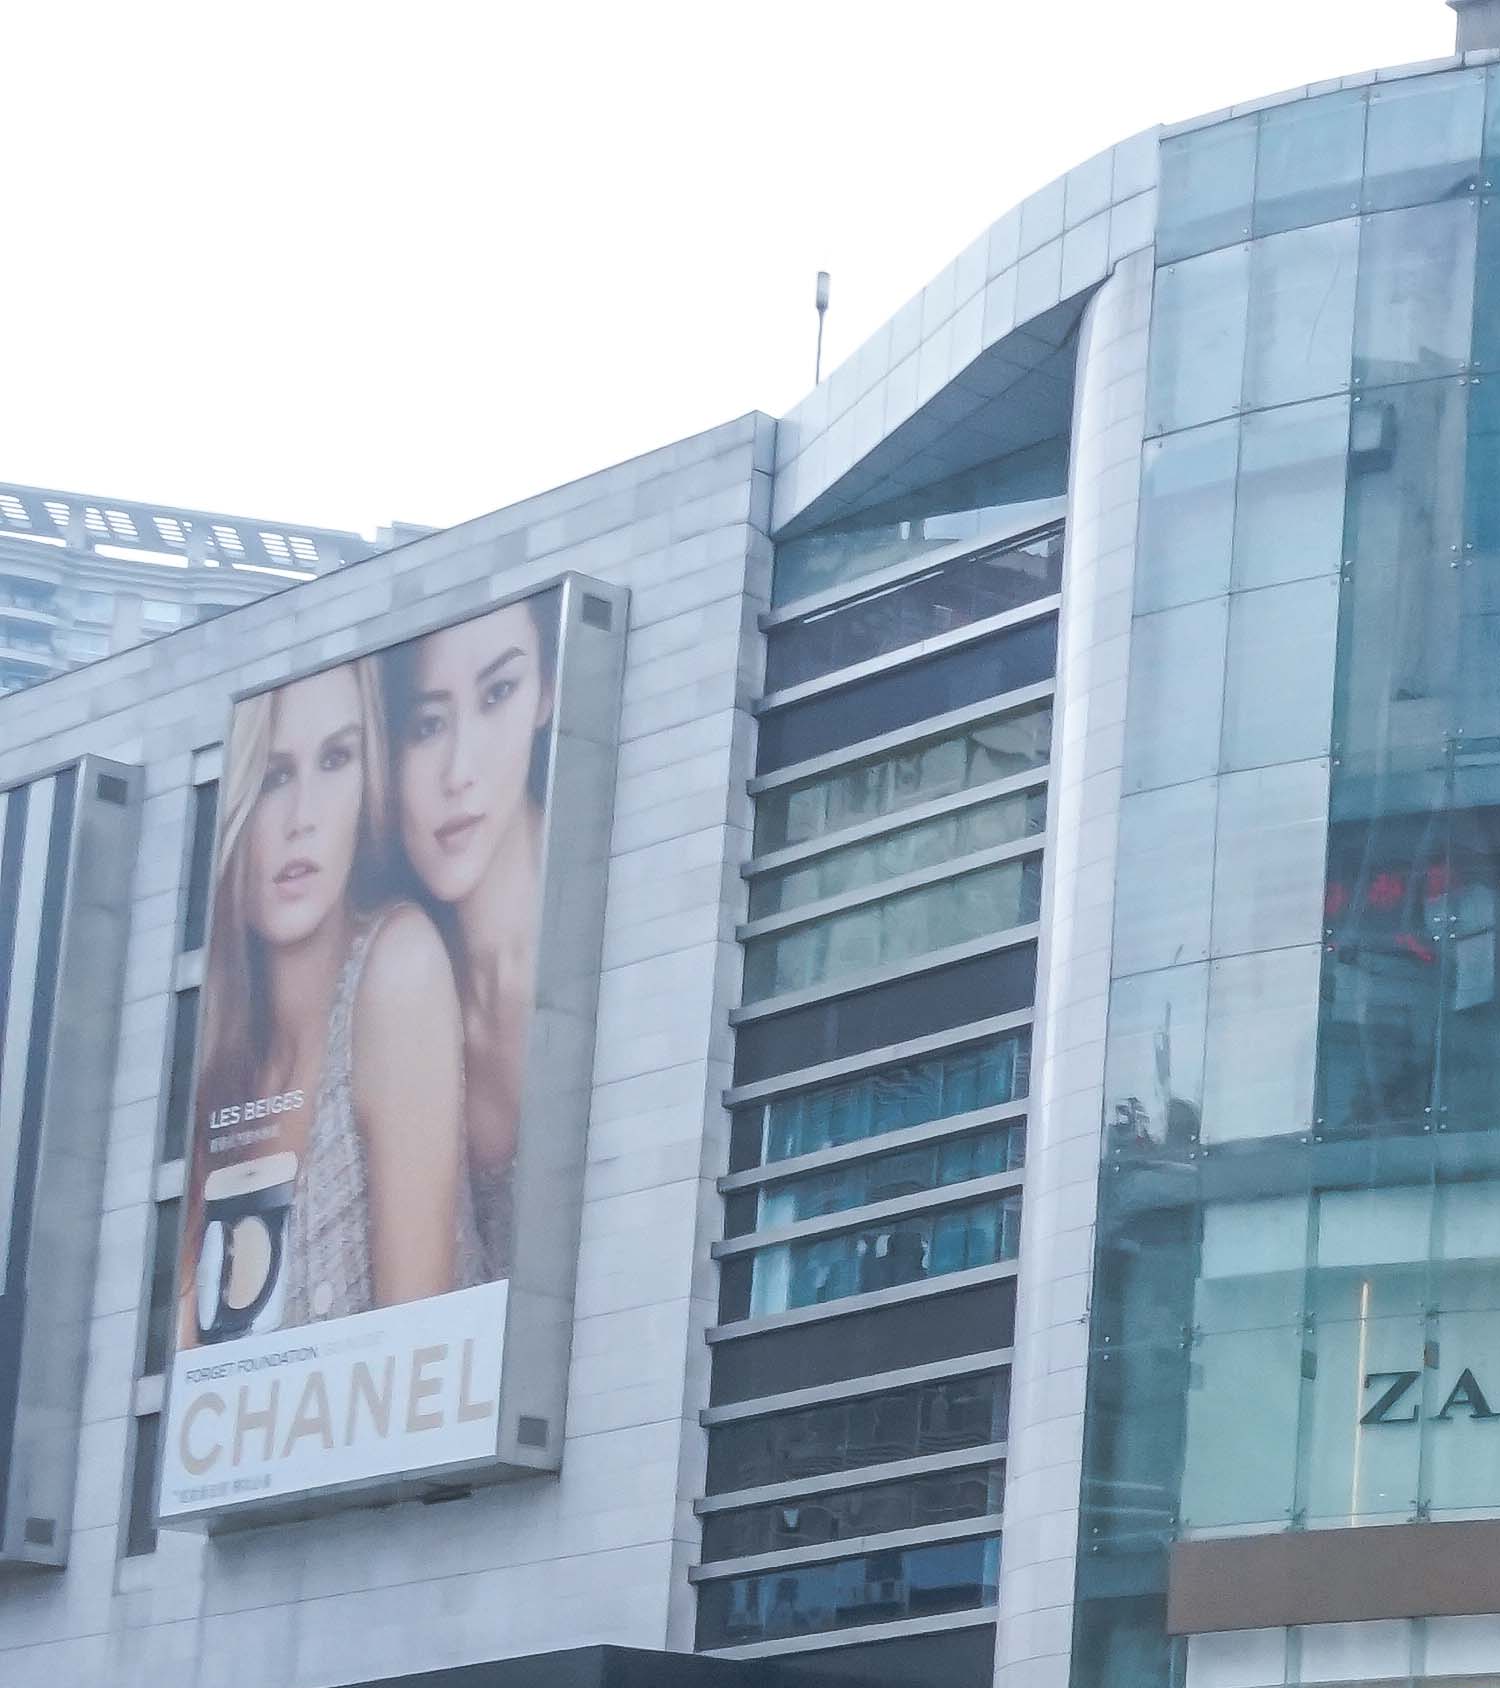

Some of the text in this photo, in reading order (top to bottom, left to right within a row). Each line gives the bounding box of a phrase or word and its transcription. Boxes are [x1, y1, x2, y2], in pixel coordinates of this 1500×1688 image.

[209, 1089, 305, 1129] LES BEIGES
[178, 1338, 493, 1476] CHANEL
